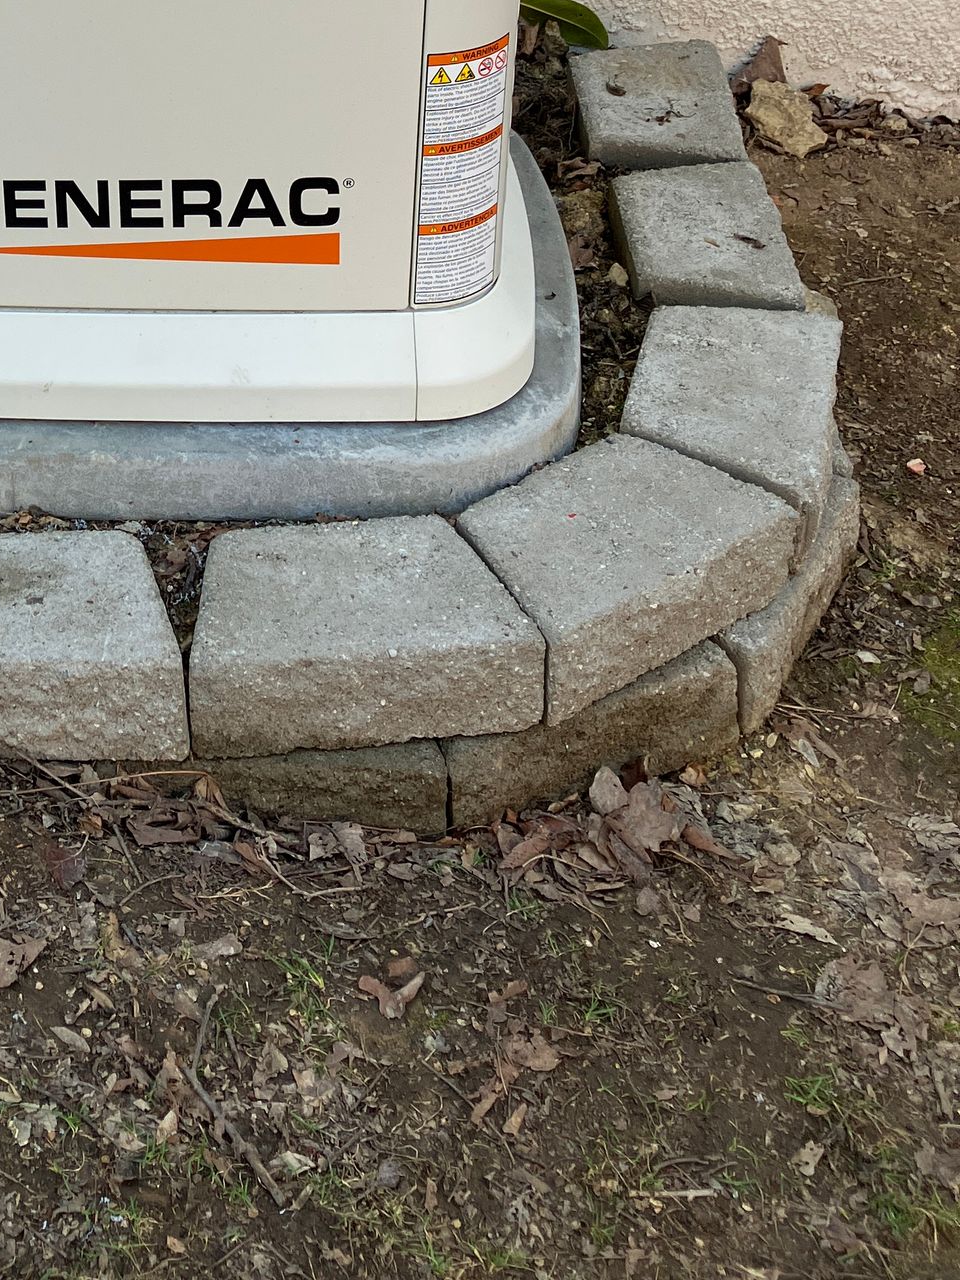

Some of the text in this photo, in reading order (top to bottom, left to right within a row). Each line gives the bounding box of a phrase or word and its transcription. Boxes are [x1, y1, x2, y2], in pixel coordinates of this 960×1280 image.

[462, 42, 499, 61] WARNING
[438, 129, 500, 153] AVERTISSEMENT
[440, 210, 494, 232] ADVERTENCIA
